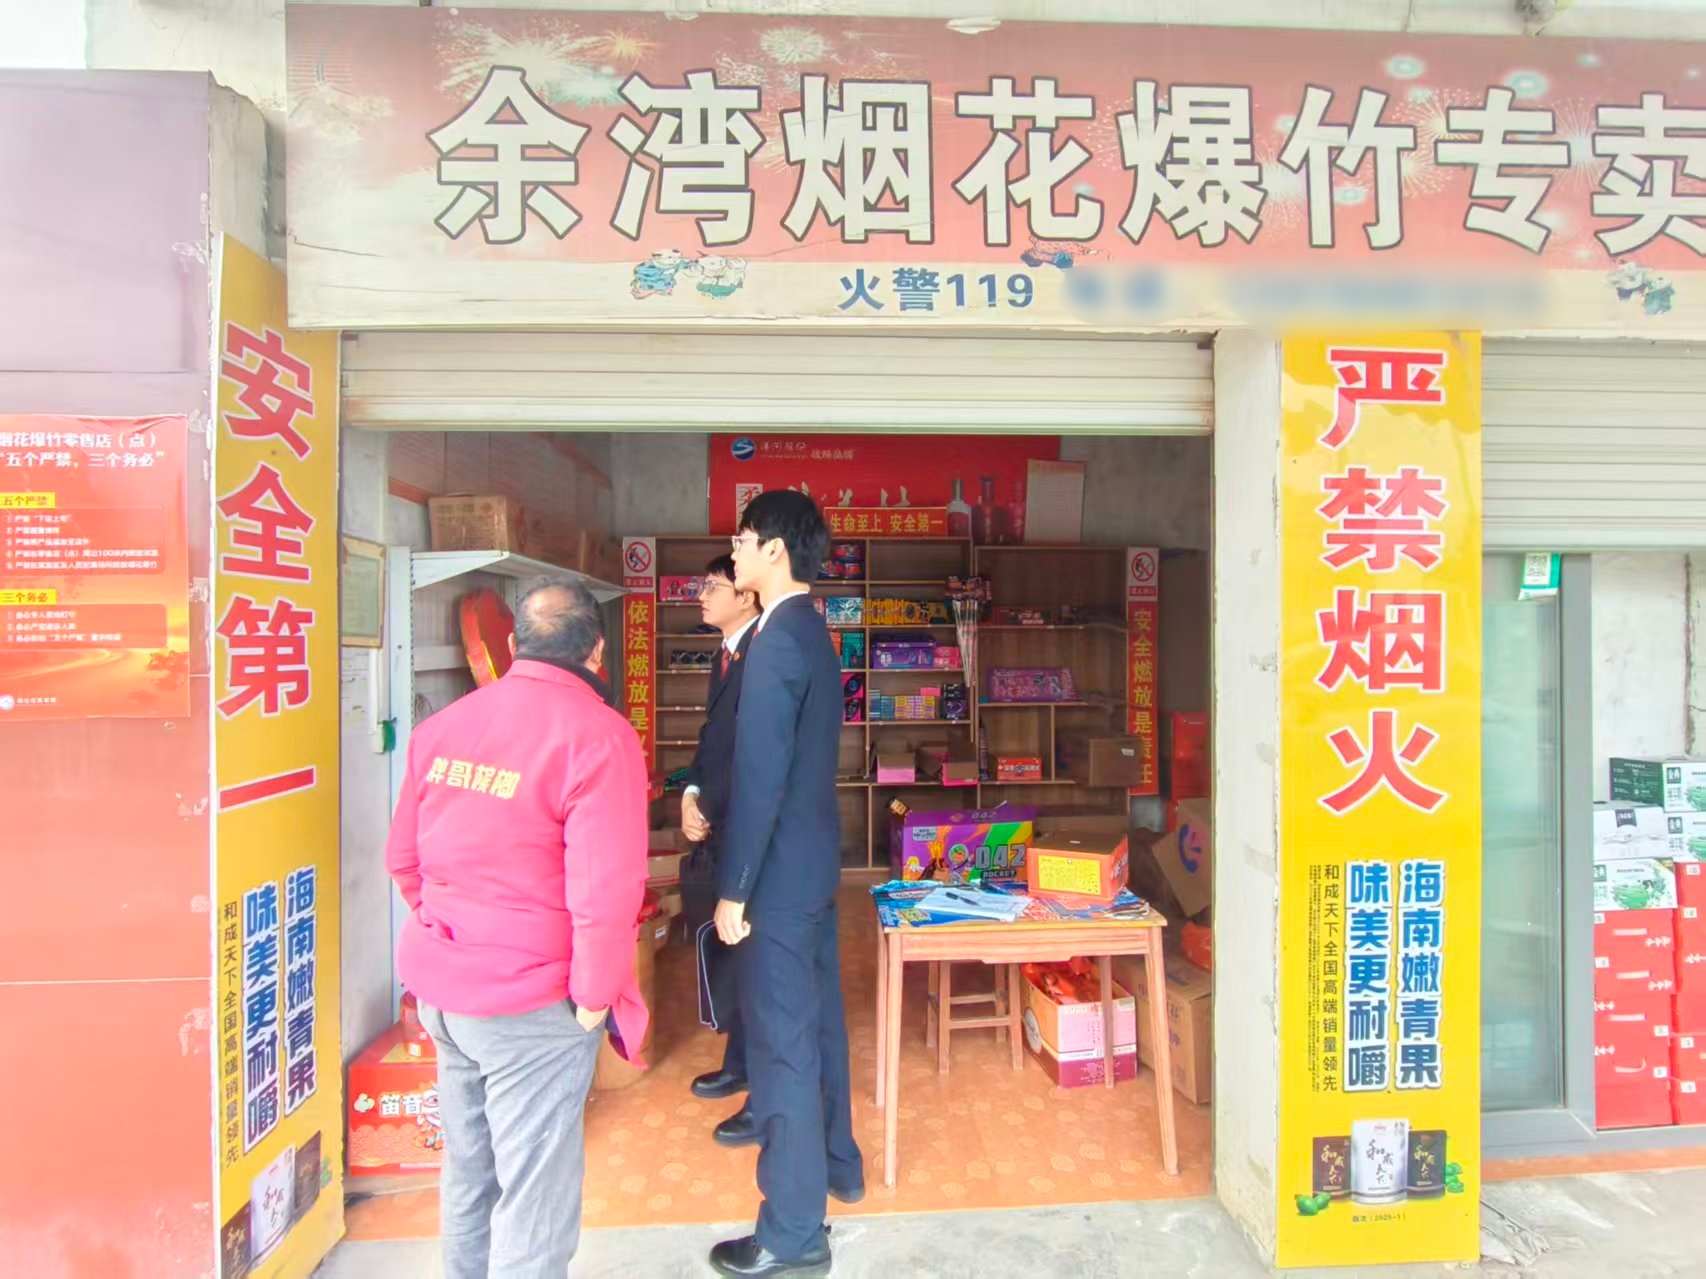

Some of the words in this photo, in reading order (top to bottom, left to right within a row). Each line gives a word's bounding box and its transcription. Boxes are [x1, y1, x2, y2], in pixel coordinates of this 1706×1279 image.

[426, 64, 1706, 256] 余湾烟花爆竹专卖
[838, 267, 1034, 311] 火警119
[3, 495, 47, 507] 五个严禁
[3, 592, 48, 603] 三个务必
[216, 320, 316, 812] 安全第一
[831, 512, 883, 533] 生命至上
[889, 512, 943, 533] 安全第一
[1317, 347, 1449, 814] 严禁烟火
[223, 901, 239, 1169] 和成天下全国高端销量领先
[245, 883, 278, 1148] 味美更耐嚼
[285, 867, 317, 1112] 海南嫩青果
[1322, 864, 1339, 1092] 和成天下全国高端销量领先
[1347, 863, 1389, 1086] 味美更耐嚼
[1398, 862, 1443, 1085] 海南嫩青果
